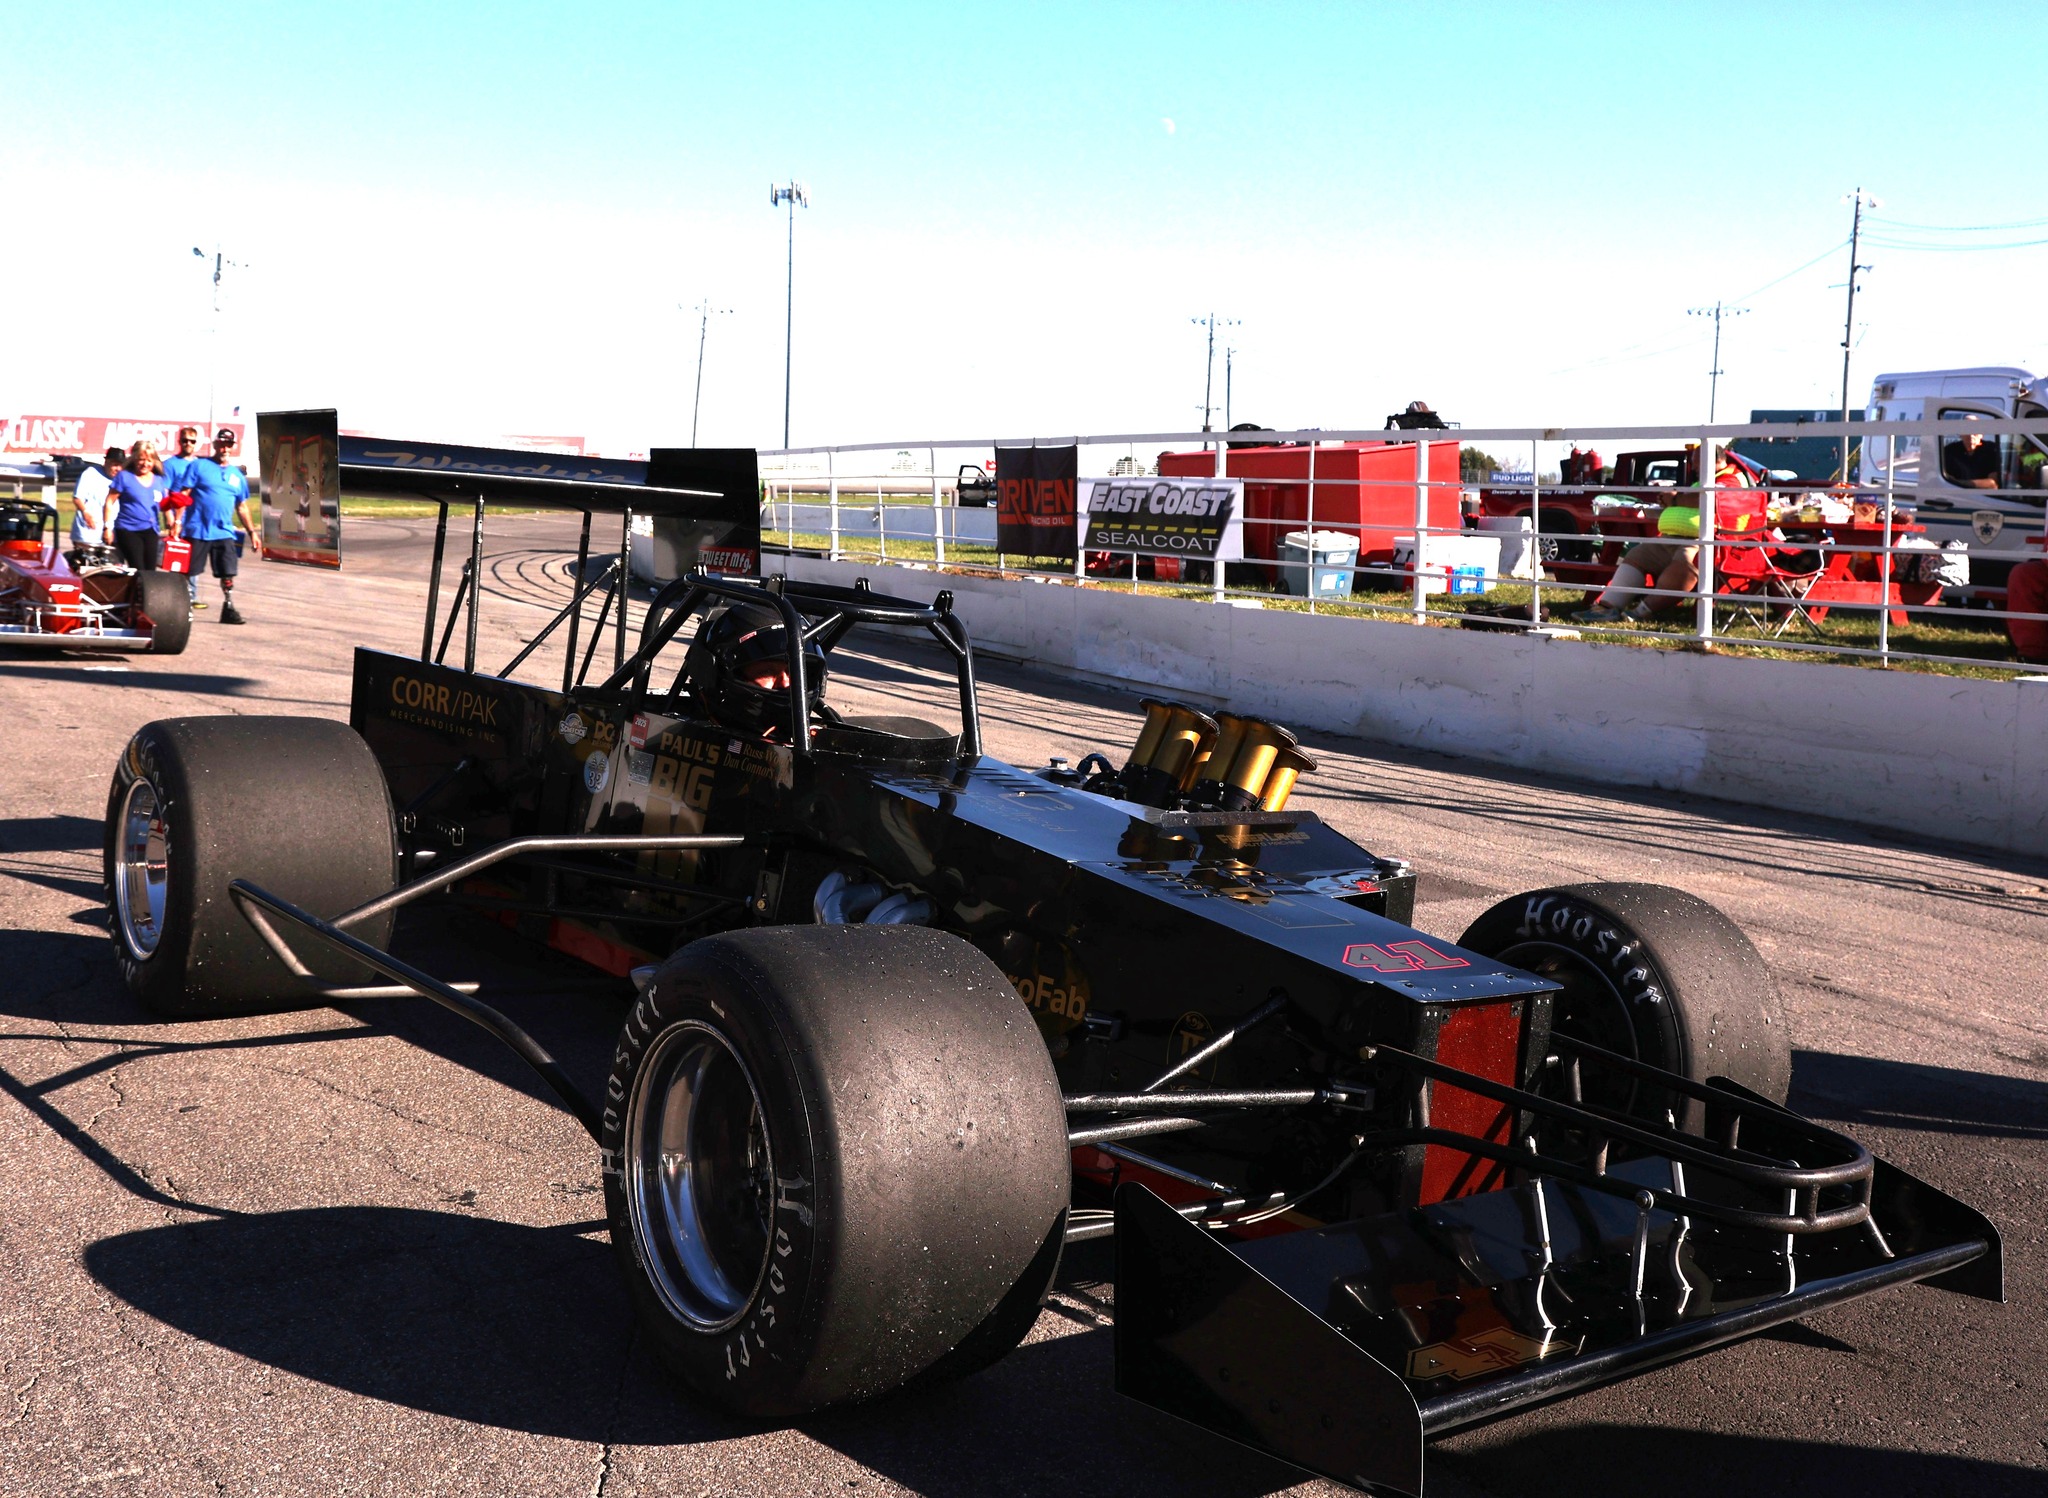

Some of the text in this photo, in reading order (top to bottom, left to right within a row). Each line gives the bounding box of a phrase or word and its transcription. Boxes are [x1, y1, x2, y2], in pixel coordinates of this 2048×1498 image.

[12, 419, 84, 449] CLASSIC
[269, 435, 330, 542] 41
[1511, 474, 1533, 482] LIGHT
[997, 478, 1074, 516] DRIVEN
[1090, 483, 1232, 516] EAST COAST
[1030, 515, 1066, 526] RACING OIL
[1096, 532, 1219, 551] SEALCOAT
[389, 709, 496, 743] MERCHANDISING INC
[660, 731, 720, 765] PAUL'S
[743, 743, 764, 760] Russ
[650, 754, 716, 811] BIG
[741, 758, 775, 780] Connors
[1342, 940, 1471, 973] 41
[1515, 896, 1661, 1005] Hoosier
[1008, 973, 1087, 1021] roFab
[602, 984, 660, 1193] Hoosier
[1404, 1326, 1577, 1381] 41
